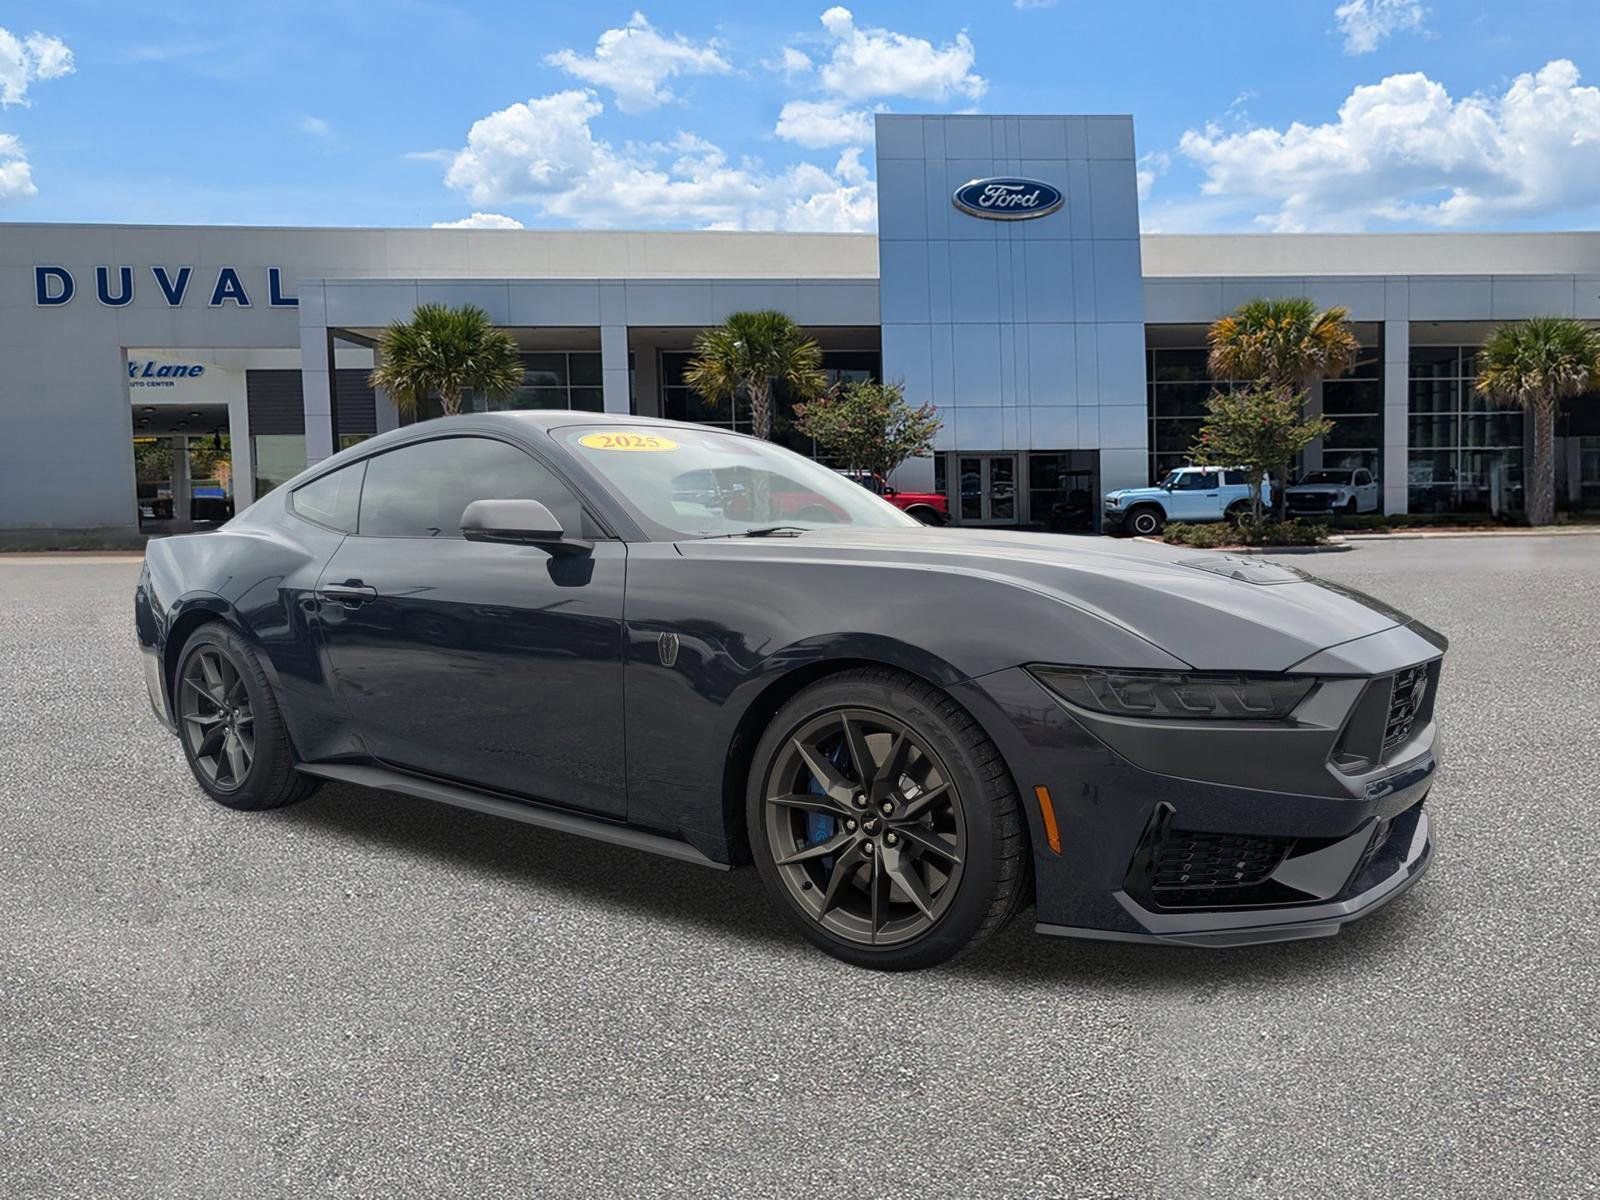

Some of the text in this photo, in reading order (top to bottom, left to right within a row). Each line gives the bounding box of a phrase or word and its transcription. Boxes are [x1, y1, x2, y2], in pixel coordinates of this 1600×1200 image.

[979, 185, 1040, 206] Ford
[34, 266, 299, 307] DUVAL
[142, 362, 204, 377] Lane
[599, 436, 660, 447] 2025
